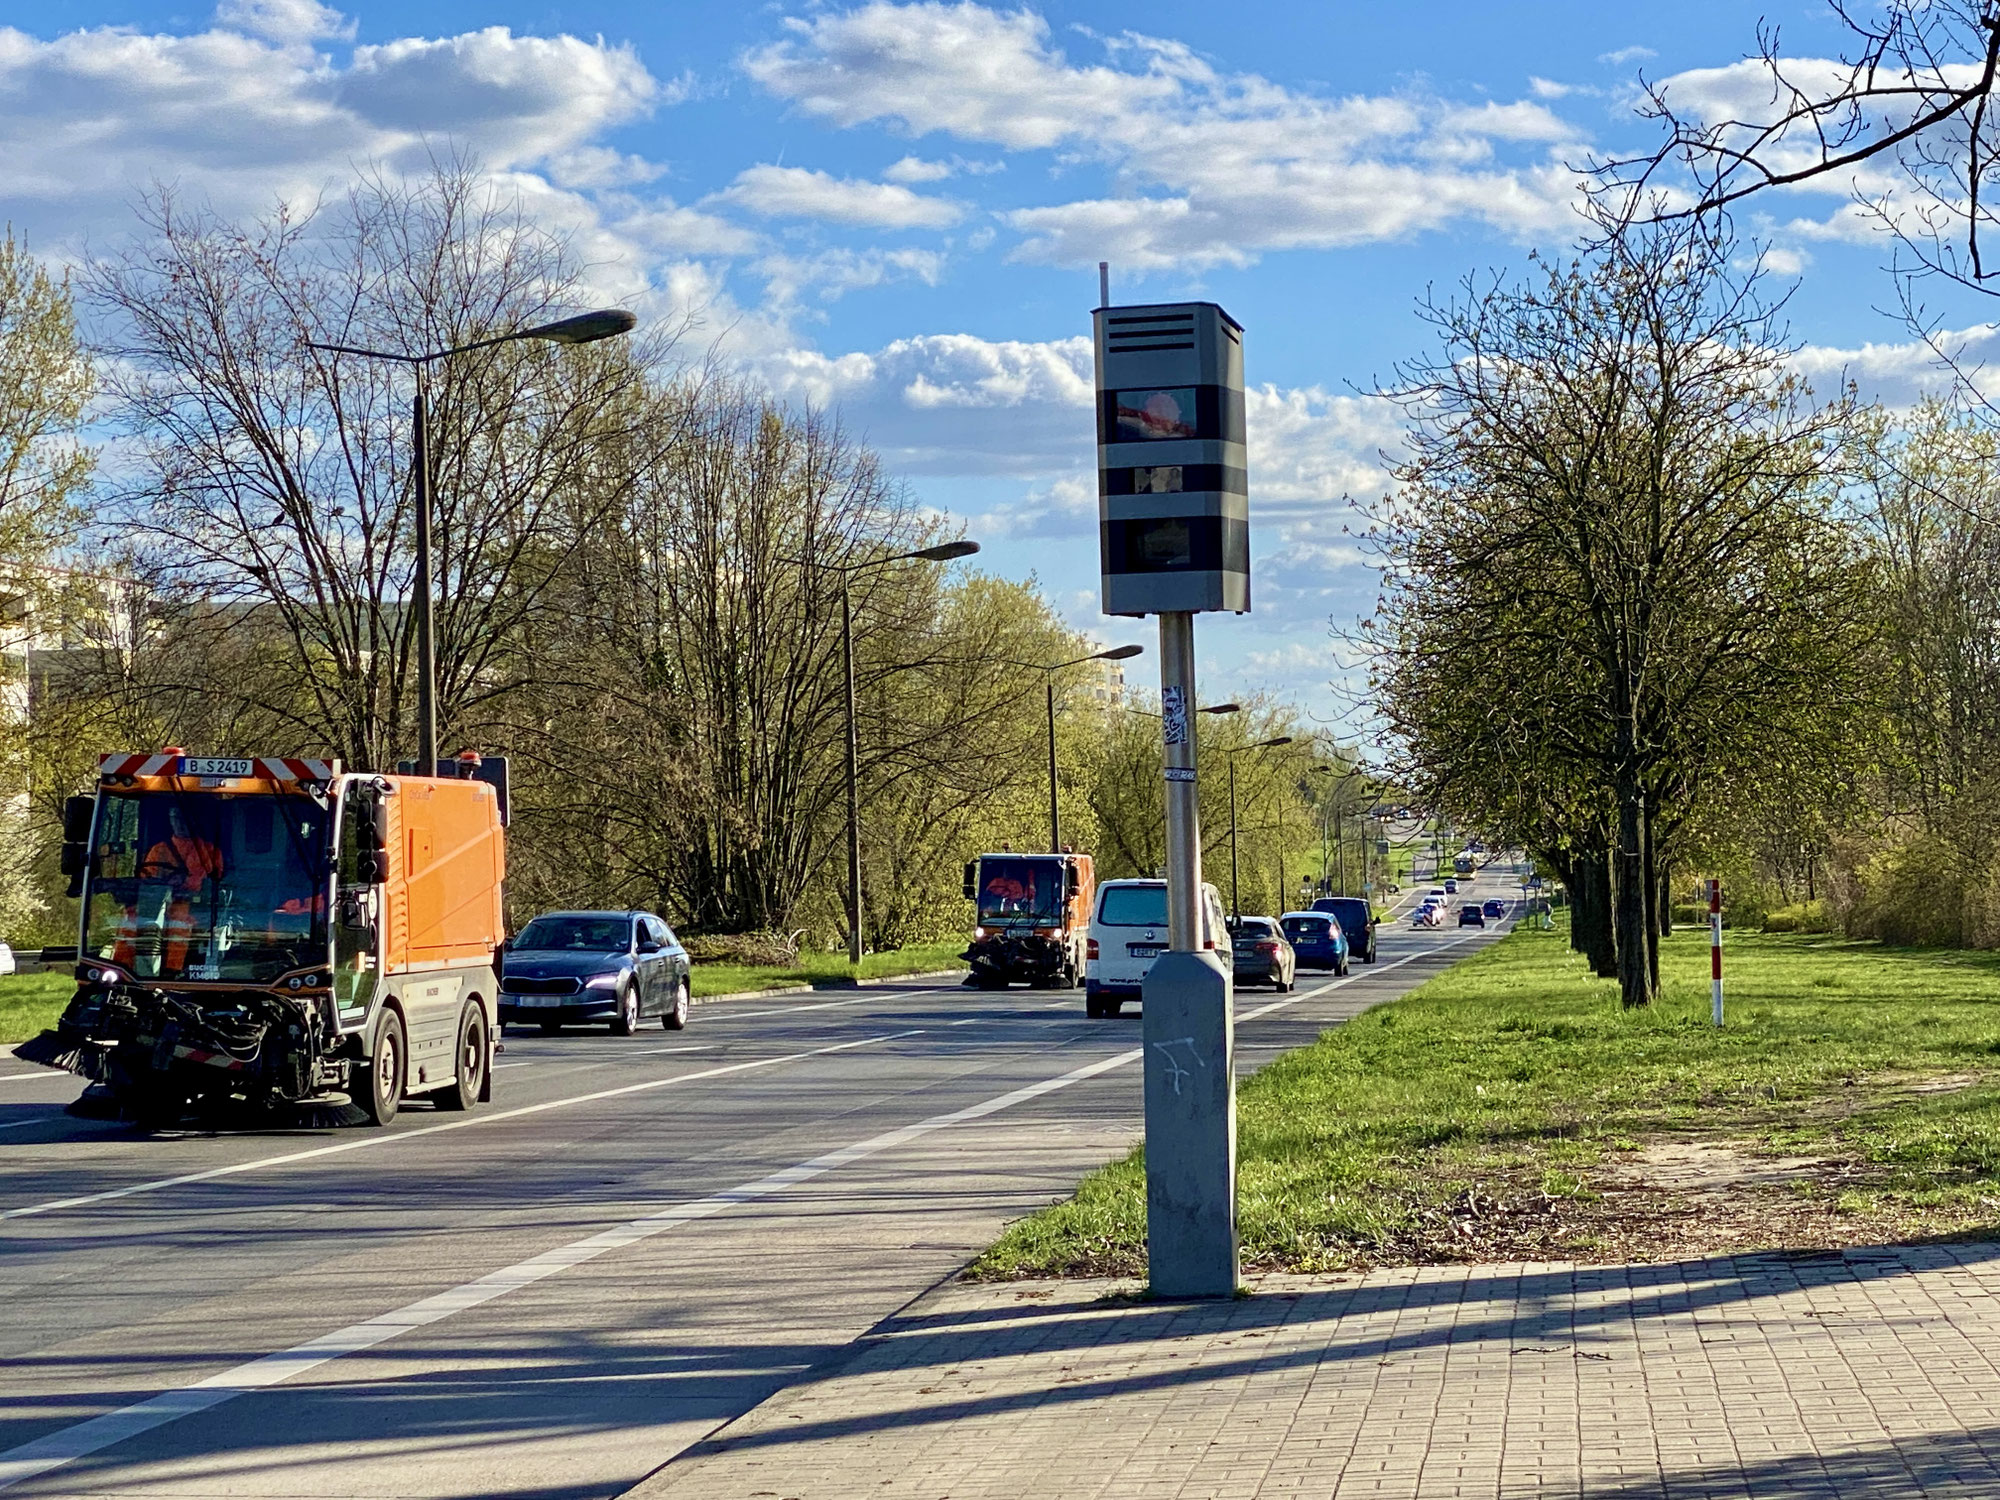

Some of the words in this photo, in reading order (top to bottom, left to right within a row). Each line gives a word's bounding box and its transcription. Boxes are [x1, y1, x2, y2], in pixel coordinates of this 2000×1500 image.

[190, 760, 198, 772] B
[206, 760, 214, 773] S
[217, 761, 248, 774] 2419
